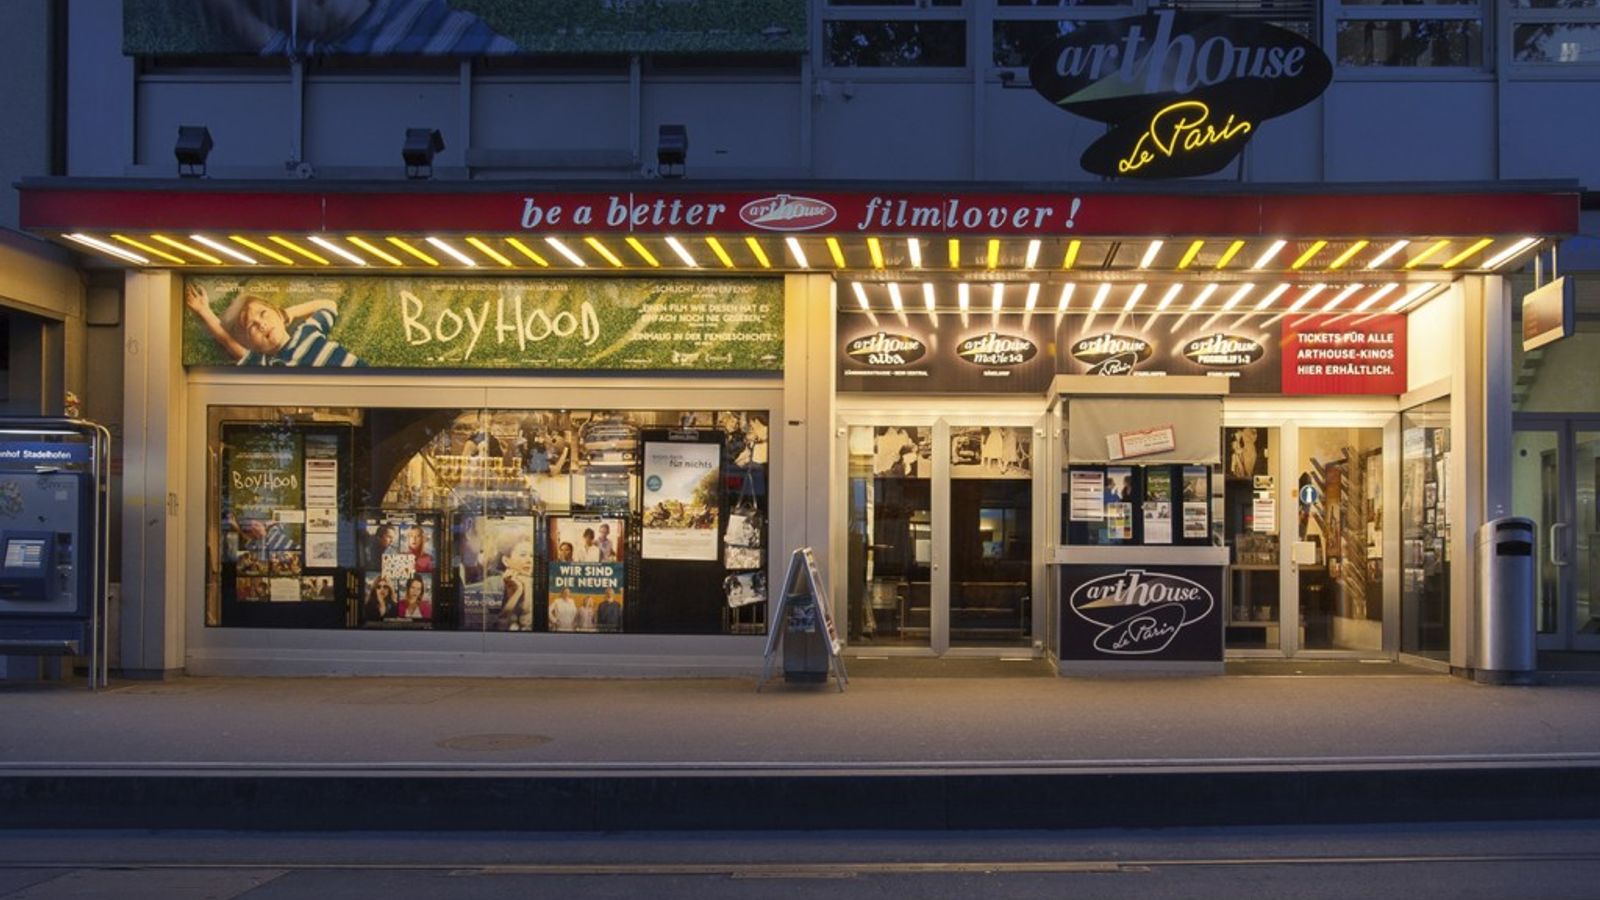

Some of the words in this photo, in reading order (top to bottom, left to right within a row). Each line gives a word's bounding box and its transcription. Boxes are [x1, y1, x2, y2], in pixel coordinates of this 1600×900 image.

[1056, 10, 1306, 94] arthouse
[1119, 131, 1154, 172] Le
[1151, 101, 1251, 157] Paris
[520, 197, 562, 229] be
[573, 204, 592, 225] a
[606, 196, 726, 226] better
[749, 197, 827, 220] arthouse
[669, 303, 688, 313] FILM
[679, 314, 704, 322] NOCH
[706, 314, 720, 322] NIE
[853, 333, 919, 353] arthouse
[964, 333, 1031, 353] arthouse
[1079, 334, 1146, 354] arthouse
[1190, 334, 1258, 354] arthouse
[1297, 333, 1341, 343] TICKETS
[1343, 331, 1365, 343] FÜR
[1367, 333, 1394, 343] ALLE
[868, 353, 906, 365] alba
[1297, 349, 1394, 359] ARTHOUSE-KINOS
[1297, 365, 1323, 375] HIER
[1325, 363, 1394, 375] ERHÄLTLICH.
[23, 449, 71, 459] Stadelhofen
[684, 460, 712, 469] nichts
[559, 565, 582, 576] WIR
[584, 565, 614, 576] SIND
[555, 577, 575, 588] DIE
[578, 577, 618, 588] NEUEN
[1086, 573, 1200, 607] arthouse
[1113, 630, 1131, 649] Le
[1128, 616, 1175, 642] Paris
